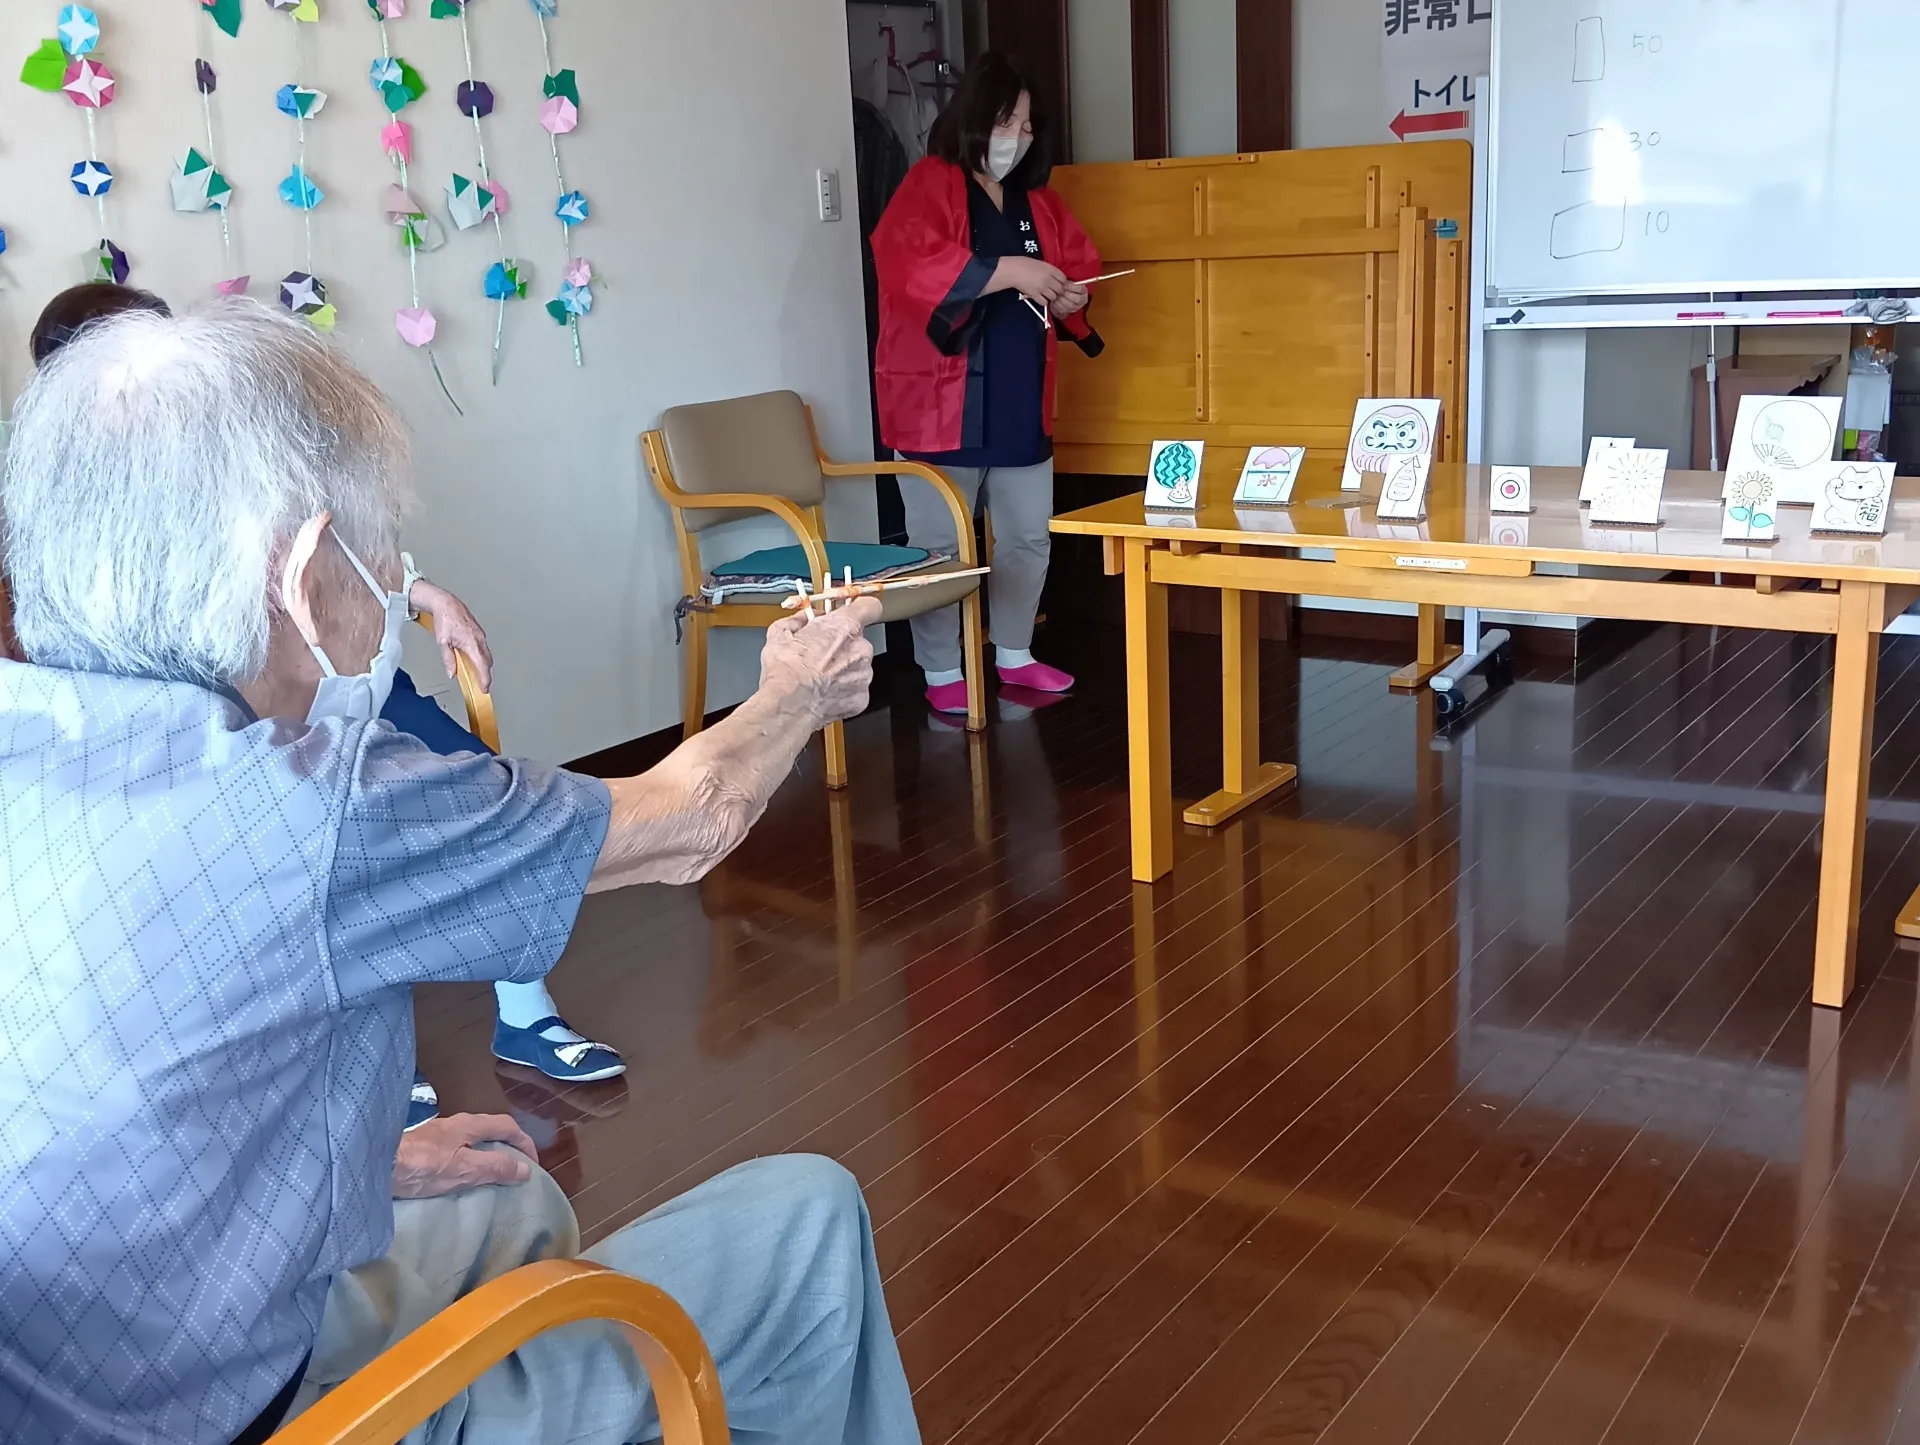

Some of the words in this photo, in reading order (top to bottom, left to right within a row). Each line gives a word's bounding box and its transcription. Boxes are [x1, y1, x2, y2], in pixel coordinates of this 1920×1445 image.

[1632, 33, 1663, 58] 50
[1630, 131, 1661, 151] 30
[1645, 210, 1670, 236] 10
[1256, 473, 1278, 487] 氷
[1858, 502, 1880, 522] 福
